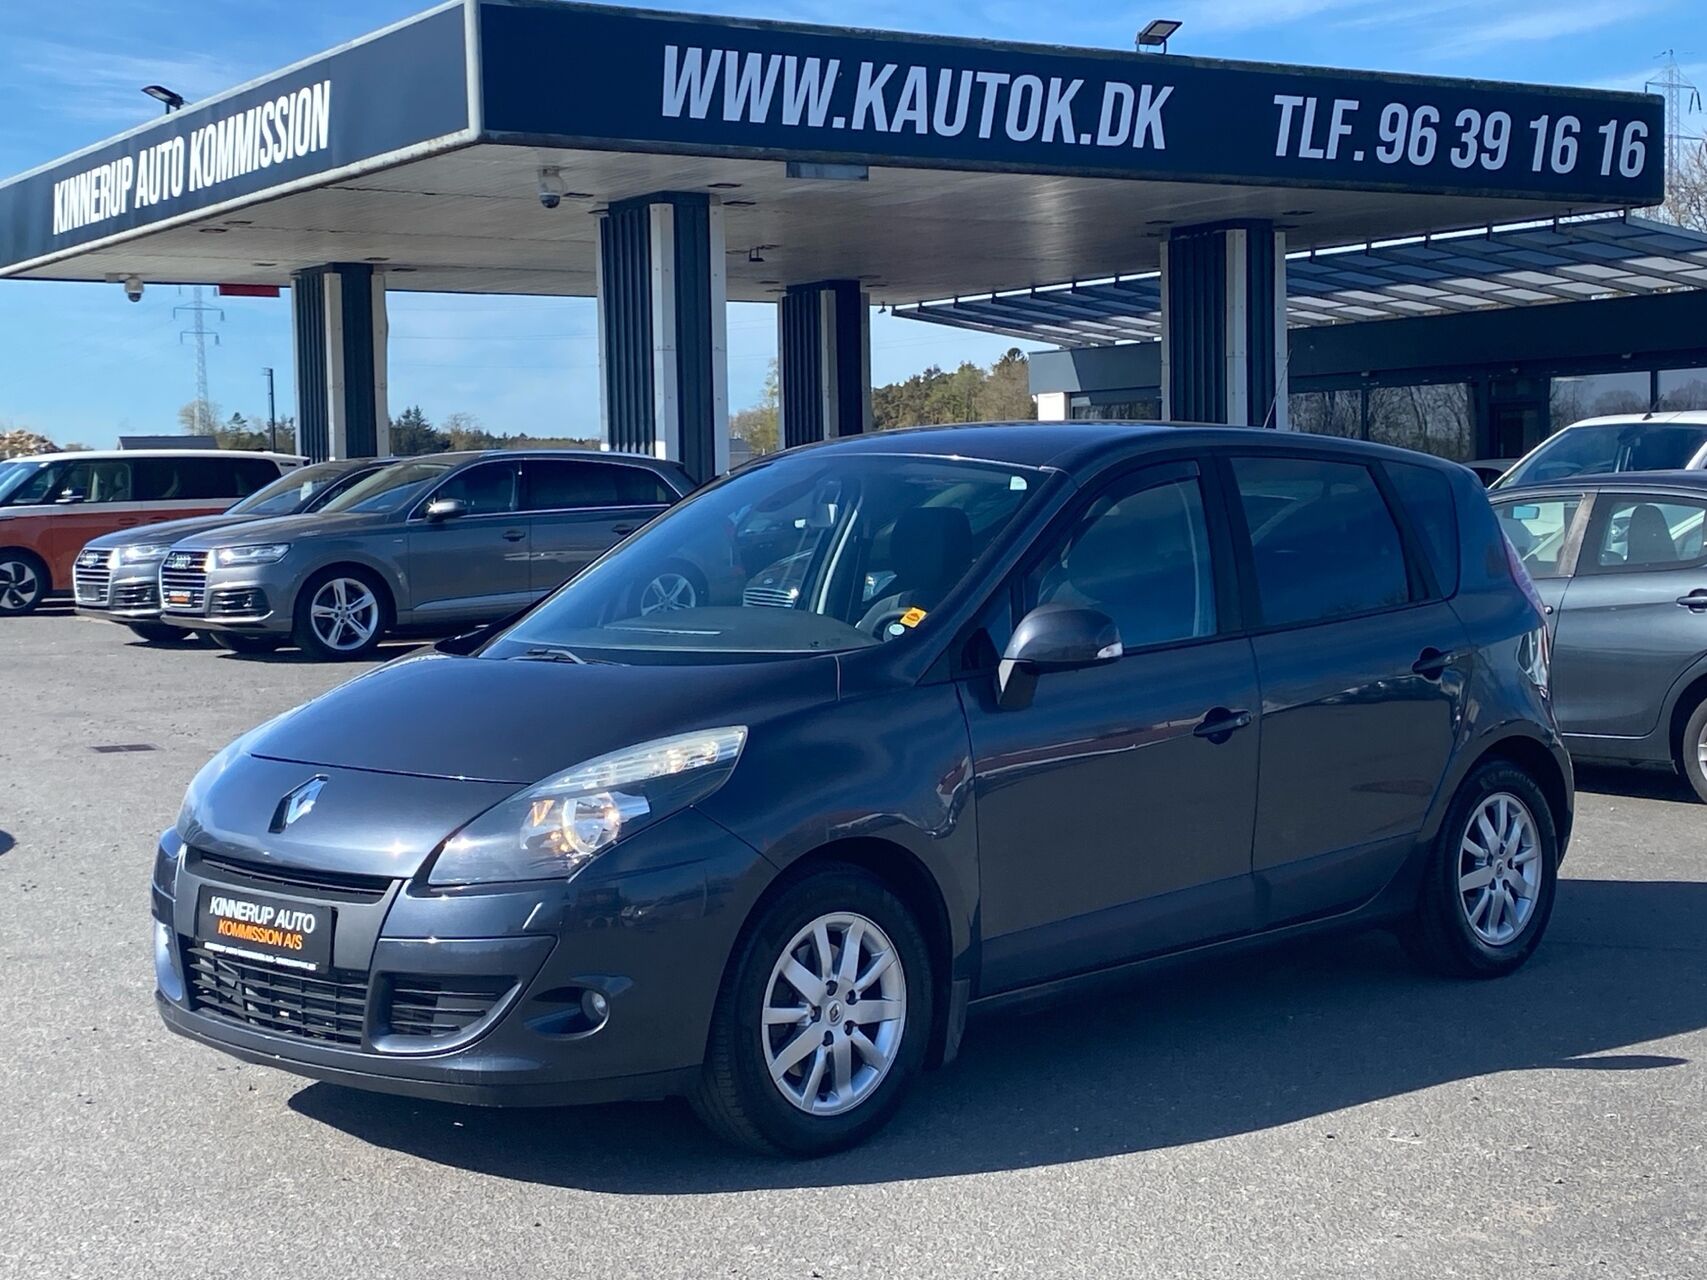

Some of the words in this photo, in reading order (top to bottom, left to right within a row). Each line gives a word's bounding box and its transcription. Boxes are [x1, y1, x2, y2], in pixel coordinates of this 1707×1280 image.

[662, 45, 1174, 150] WWW.KAUTOK.DK
[1274, 95, 1364, 161] TLF.
[1376, 103, 1440, 166] 96
[1450, 109, 1511, 170] 39
[1529, 115, 1581, 174] 16
[1599, 120, 1648, 178] 16
[53, 156, 133, 235] KINNERUP
[135, 136, 184, 209] AUTO
[189, 80, 331, 192] KOMMISSION
[209, 896, 274, 925] KINNERUP
[274, 909, 315, 933] AUTO
[218, 919, 282, 946] KOMMISSION
[283, 932, 303, 950] A/S
